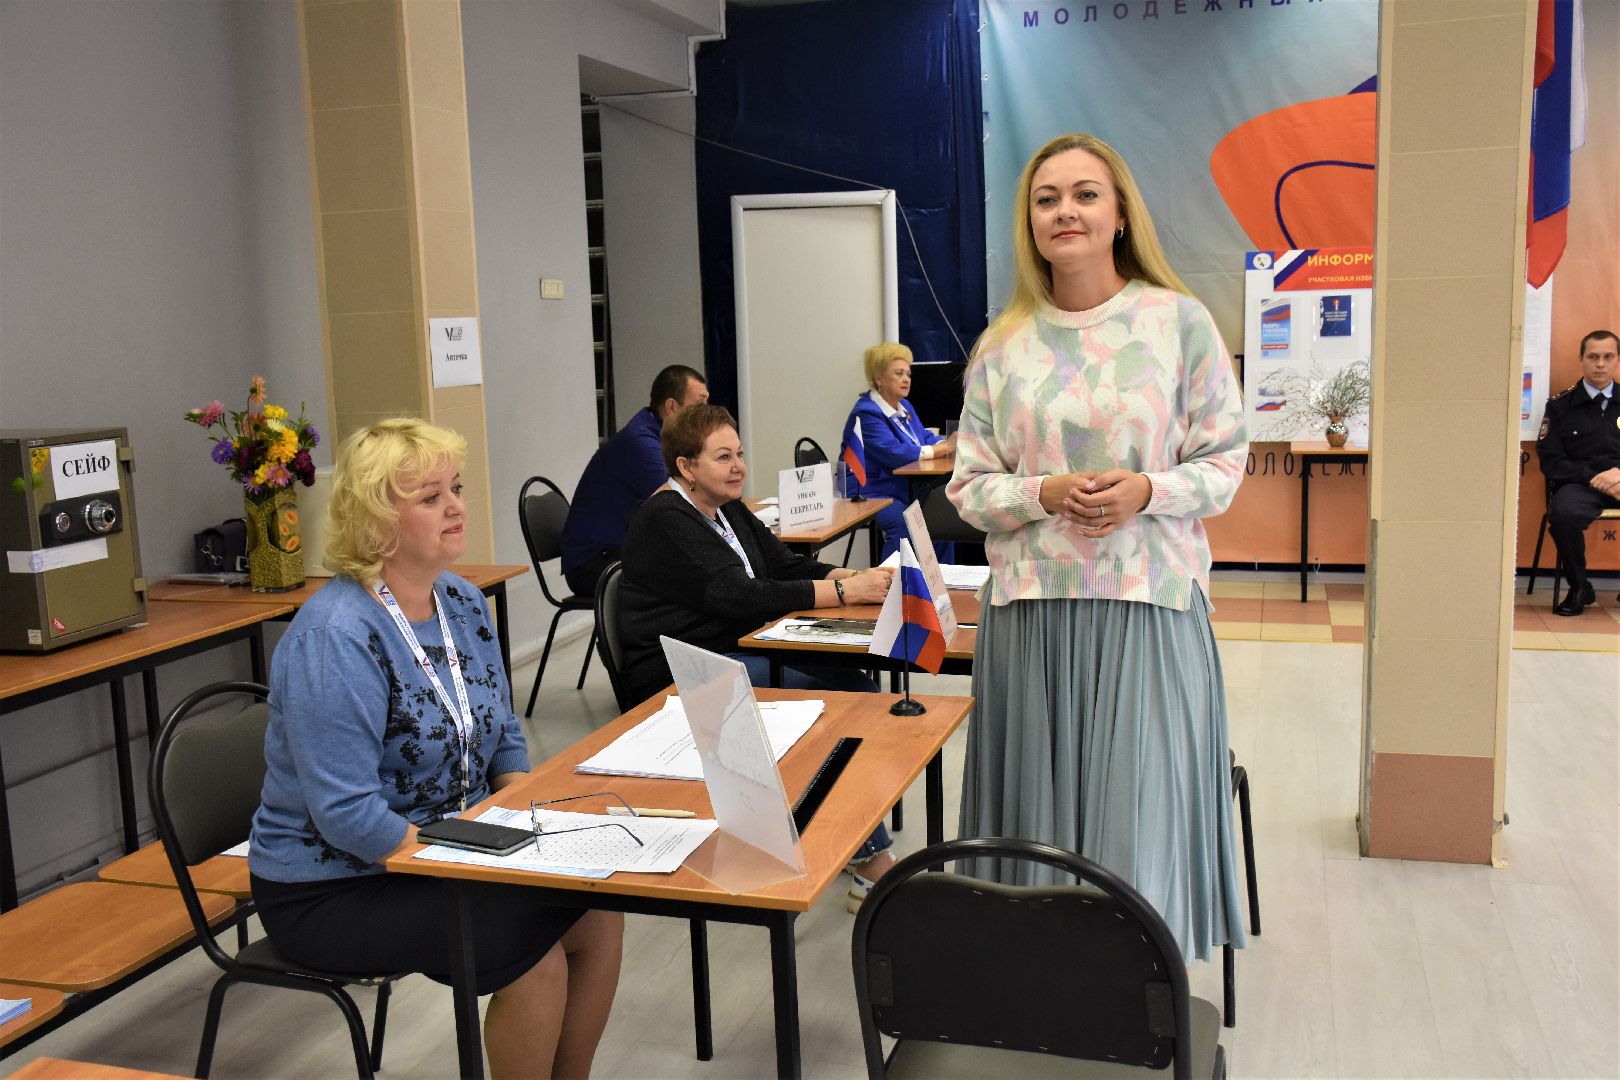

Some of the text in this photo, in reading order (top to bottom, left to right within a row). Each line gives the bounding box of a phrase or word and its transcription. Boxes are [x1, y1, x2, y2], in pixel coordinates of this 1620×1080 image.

[1023, 0, 1324, 28] МОЛОДЕЖН
[62, 452, 111, 477] СЕЙФ
[790, 502, 824, 515] СЕКРЕТАРЬ
